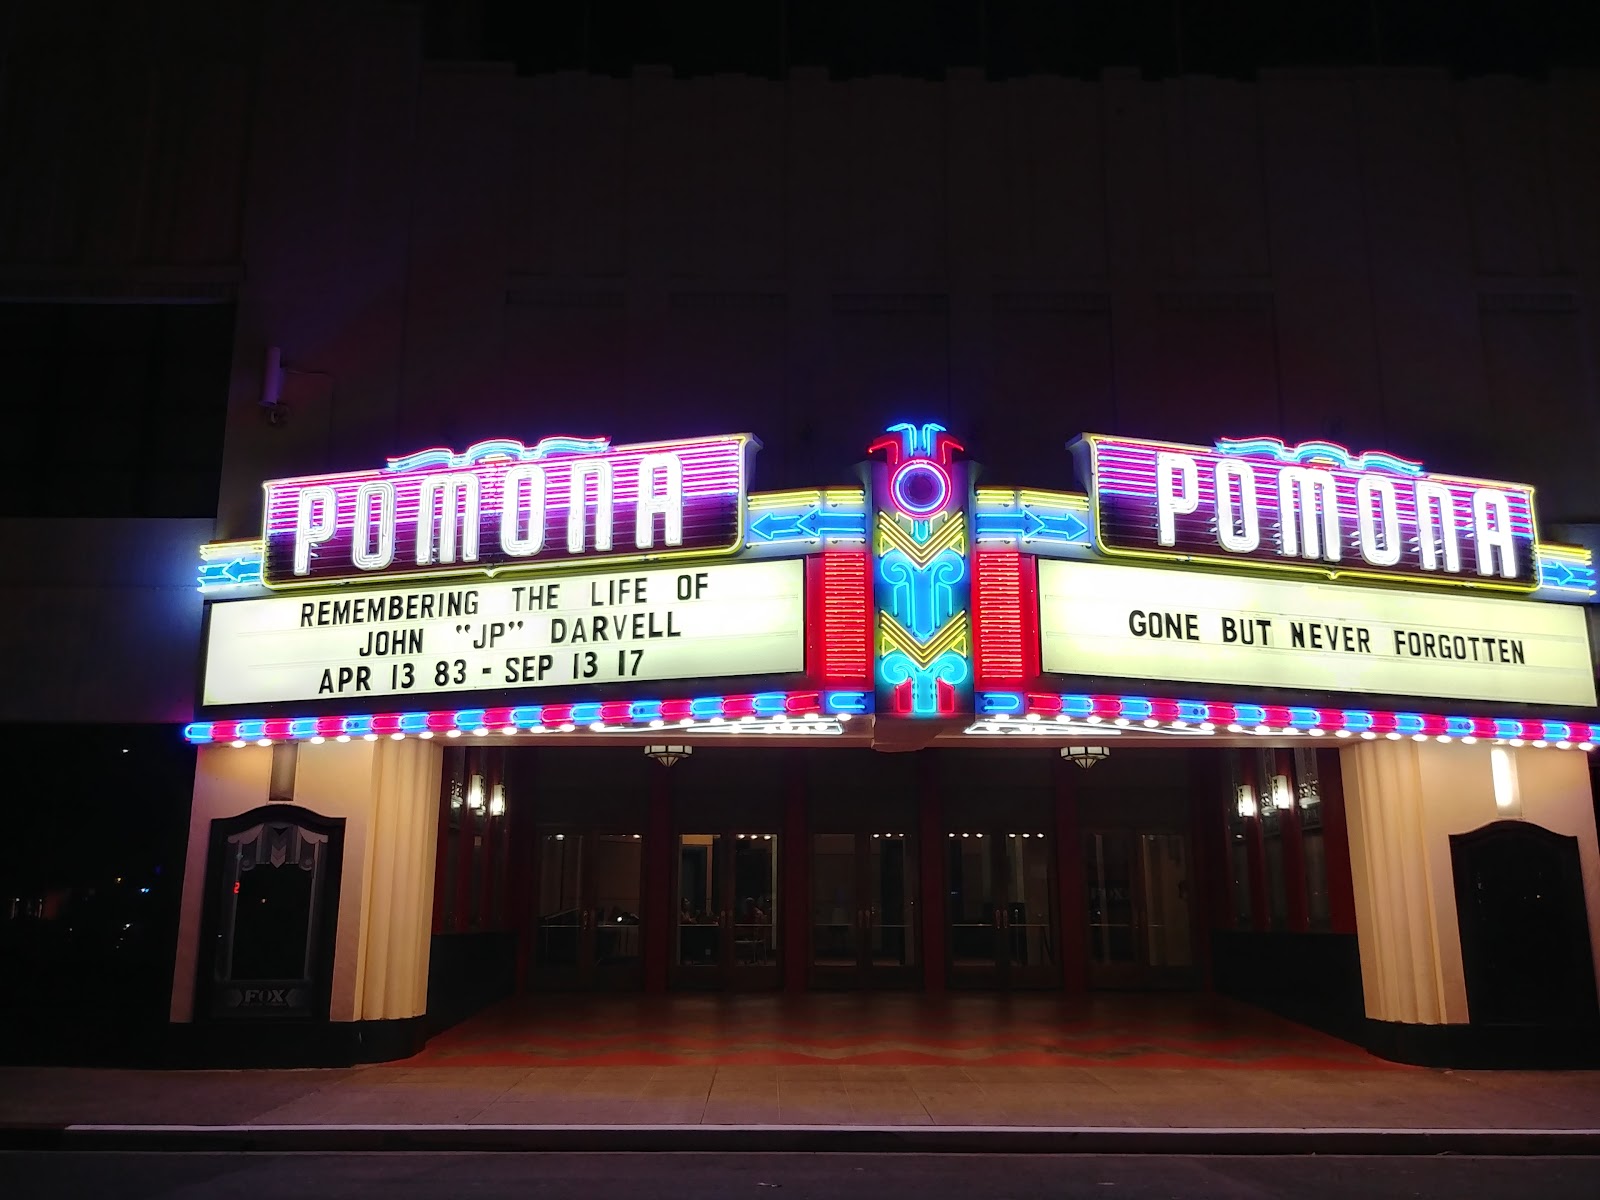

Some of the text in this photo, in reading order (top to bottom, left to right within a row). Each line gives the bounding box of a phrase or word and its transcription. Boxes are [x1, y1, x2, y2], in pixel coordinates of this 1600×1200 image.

[293, 453, 683, 576] POMONA
[1156, 452, 1518, 578] POMONA
[300, 572, 708, 628] REMEMBERING THE LIFE OF
[359, 628, 424, 657] JOHN
[551, 611, 681, 644] DARVELL
[1128, 609, 1525, 665] GONE BUT NEVER FORGOTTEN
[318, 665, 371, 695] APR
[391, 662, 415, 690] 13
[434, 659, 467, 687] 83
[505, 654, 553, 683] SEP
[573, 651, 598, 680] 13
[618, 649, 644, 677] 17
[245, 989, 286, 1002] FOX
